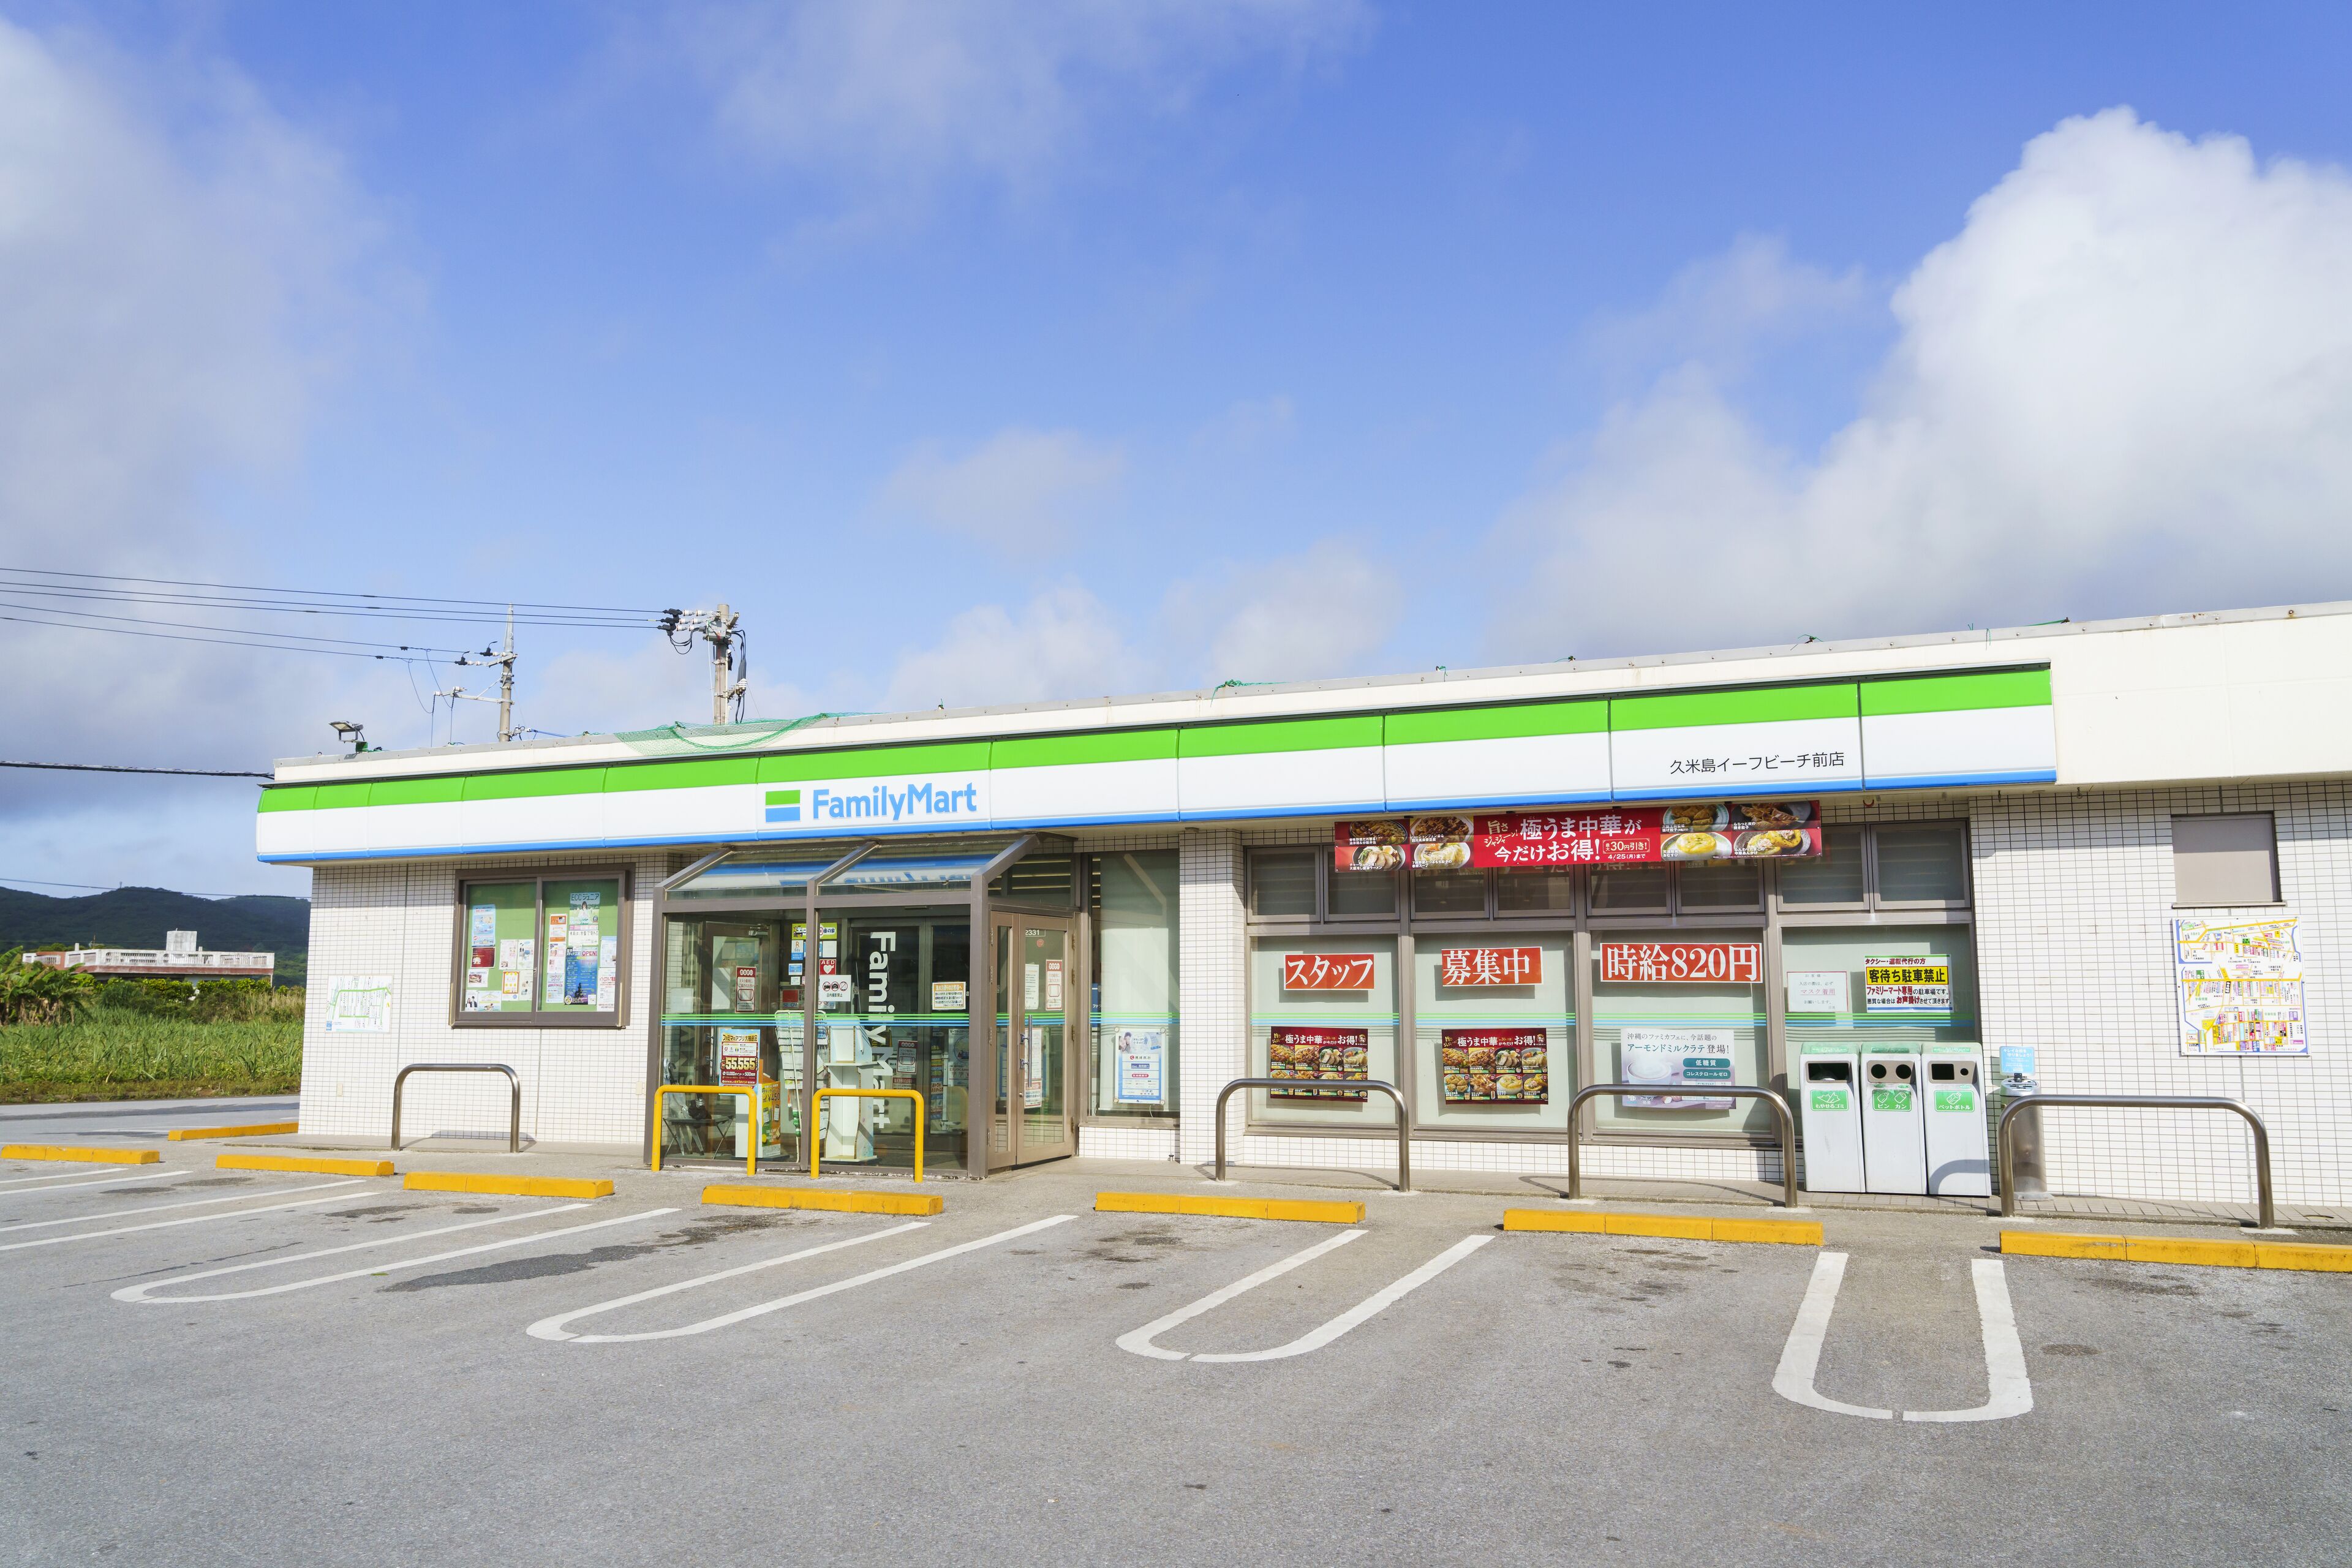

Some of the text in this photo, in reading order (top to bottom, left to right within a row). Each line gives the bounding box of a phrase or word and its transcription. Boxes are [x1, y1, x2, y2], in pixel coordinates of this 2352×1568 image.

[1670, 752, 1844, 774] 久米島イーフビーチ前店
[813, 782, 977, 821] FamilyMart
[1488, 820, 1508, 835] 旨さ
[1520, 815, 1642, 840] 極うま中華が
[1494, 839, 1600, 862] 今だけお得!
[1286, 956, 1373, 988] スタッフ
[1443, 949, 1530, 985] 募集中
[1607, 944, 1758, 982] 時給820円
[1869, 968, 1946, 982] 客待ち駐車禁止
[1285, 1034, 1323, 1044] 極うま中華
[1338, 1035, 1358, 1046] お得!
[1457, 1036, 1498, 1047] 極うま中華
[1513, 1035, 1536, 1046] お得!
